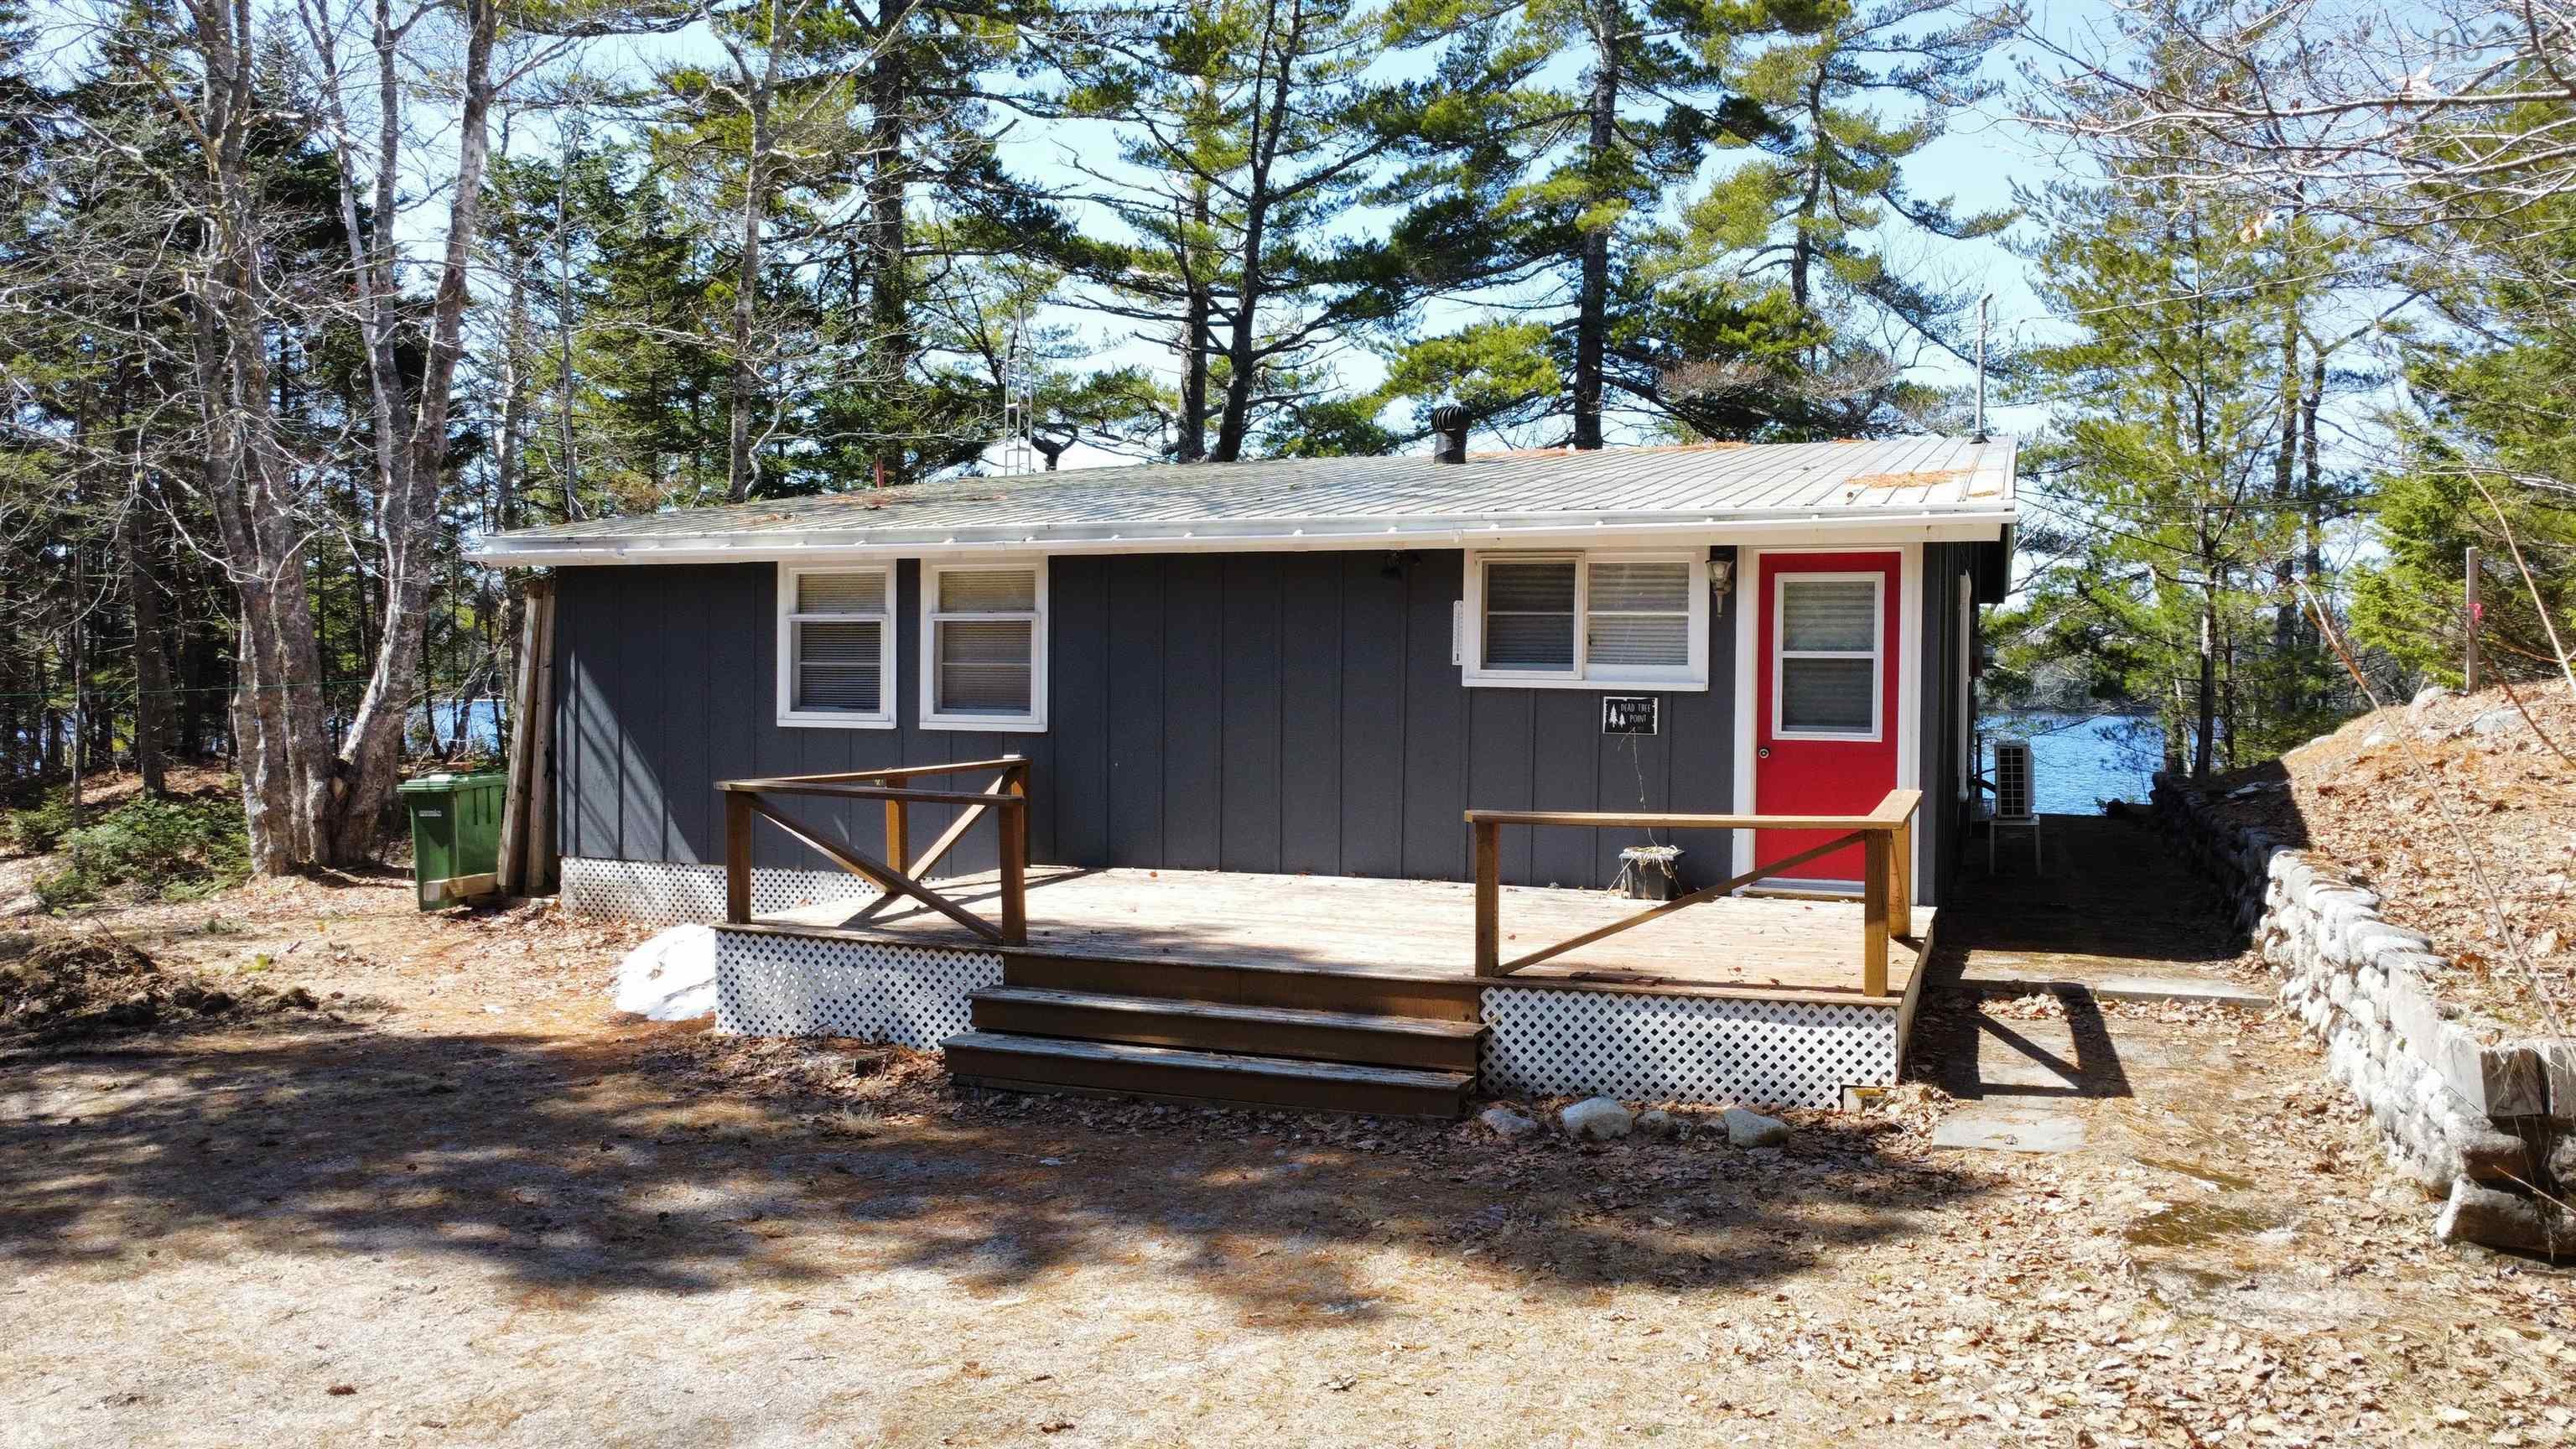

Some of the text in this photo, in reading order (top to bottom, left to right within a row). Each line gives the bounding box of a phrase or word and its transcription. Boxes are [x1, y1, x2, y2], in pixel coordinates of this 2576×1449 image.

[1620, 703, 1651, 713] DEAD TREE
[1629, 714, 1647, 724] POINT
